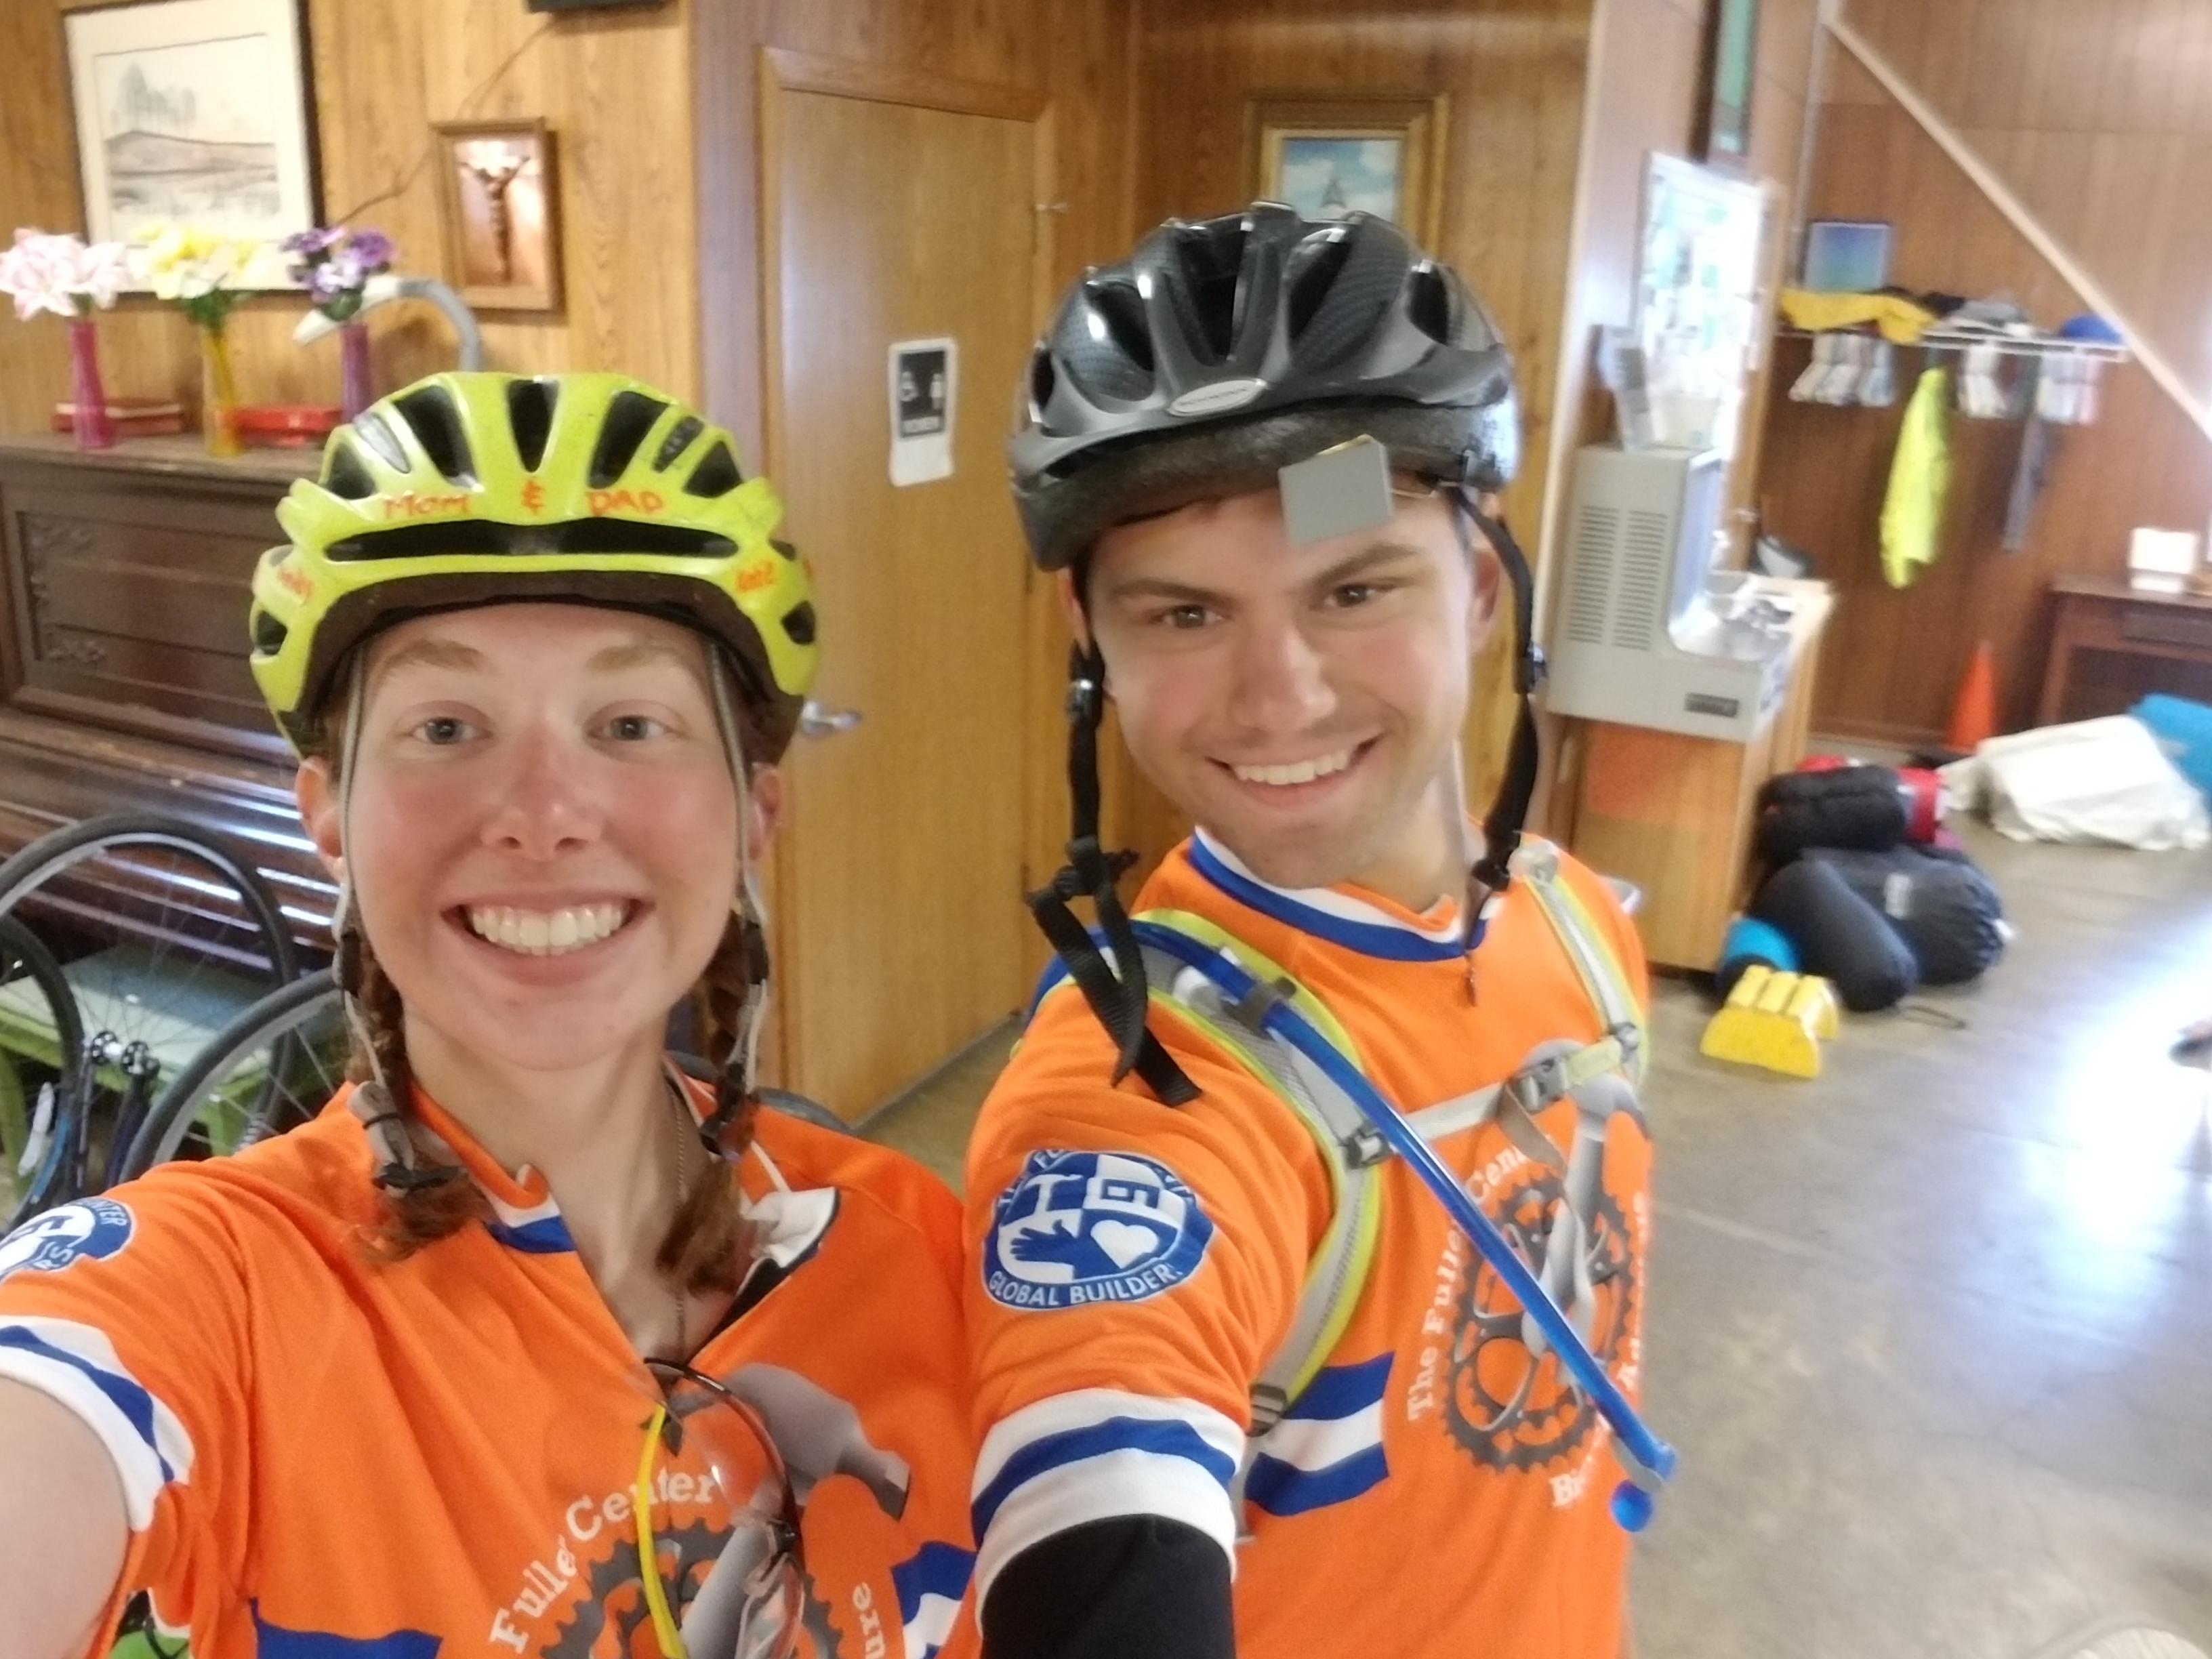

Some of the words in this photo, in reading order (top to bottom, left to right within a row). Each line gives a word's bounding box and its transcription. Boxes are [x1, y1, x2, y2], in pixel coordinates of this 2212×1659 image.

[585, 489, 663, 517] DAD
[1465, 1145, 1530, 1205] Cent
[989, 1270, 1059, 1306] GLOBAL
[1422, 1221, 1461, 1335] Fulle
[1408, 1346, 1438, 1420] The
